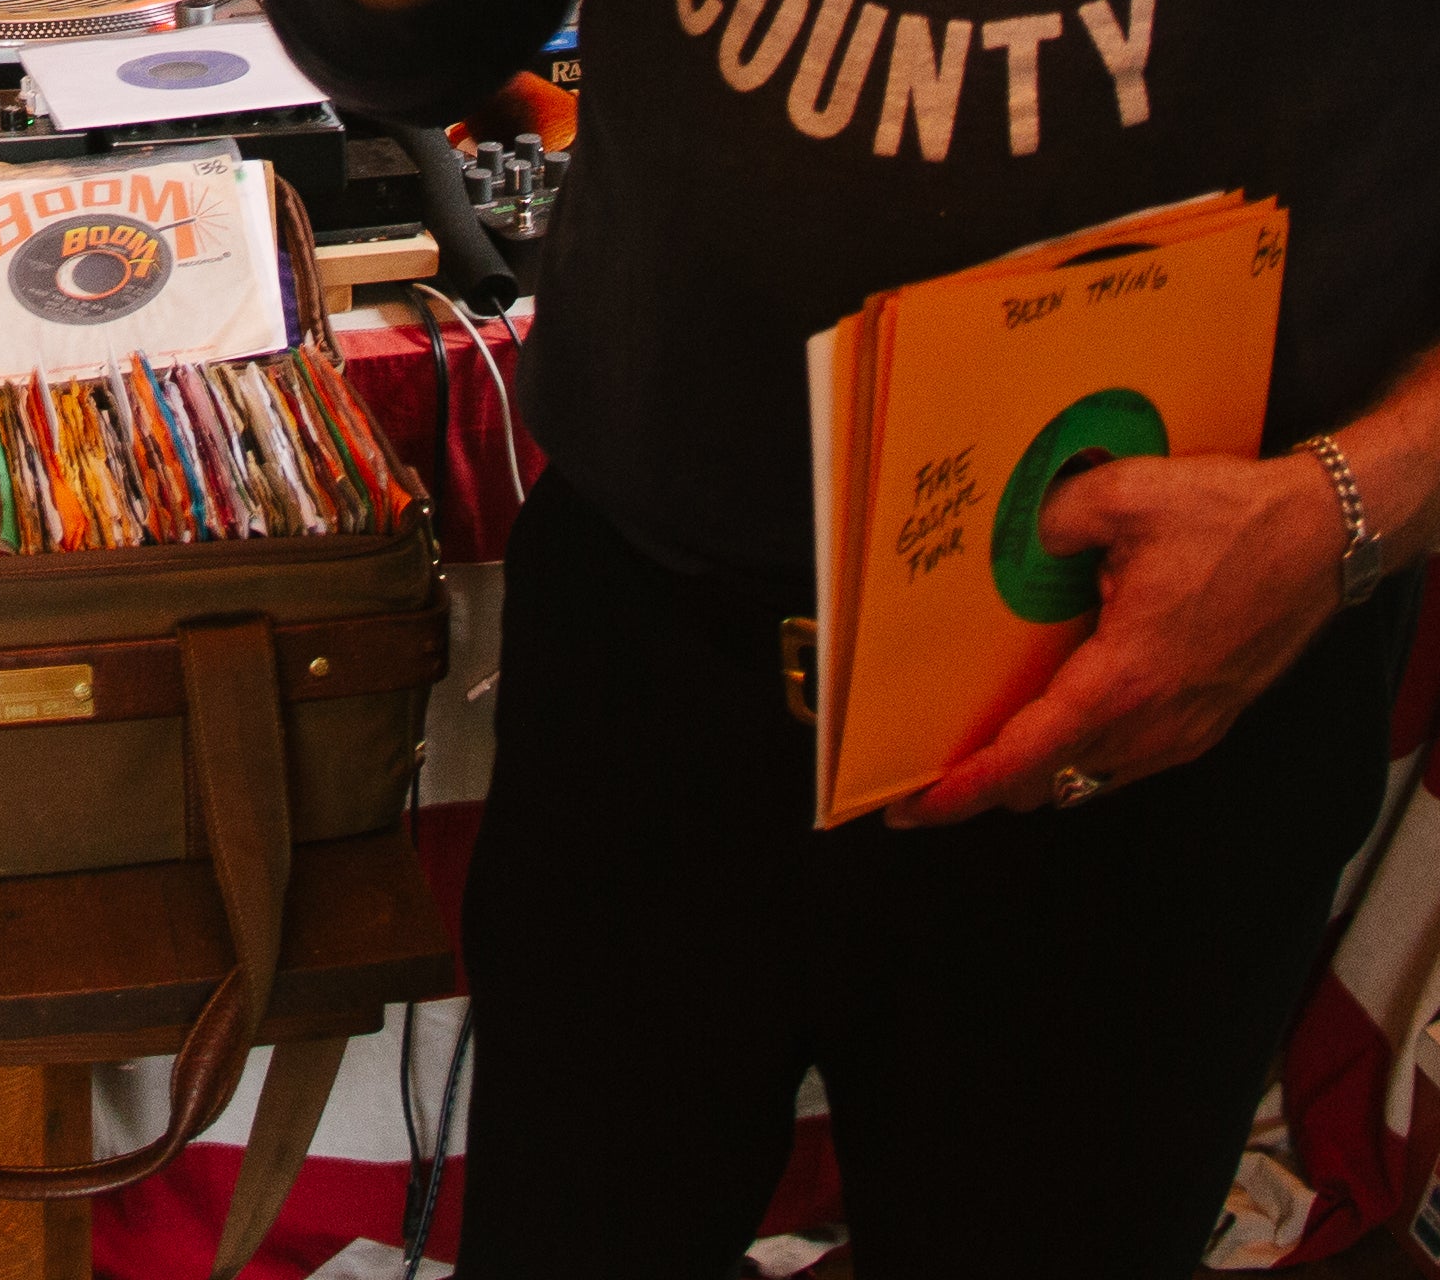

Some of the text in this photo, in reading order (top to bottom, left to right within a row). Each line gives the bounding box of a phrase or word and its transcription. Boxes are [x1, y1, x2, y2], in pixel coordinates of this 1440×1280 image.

[192, 159, 229, 177] 138
[61, 226, 160, 278] BOOM
[1001, 261, 1169, 330] BEEN TRYING
[913, 443, 978, 508] FIRE
